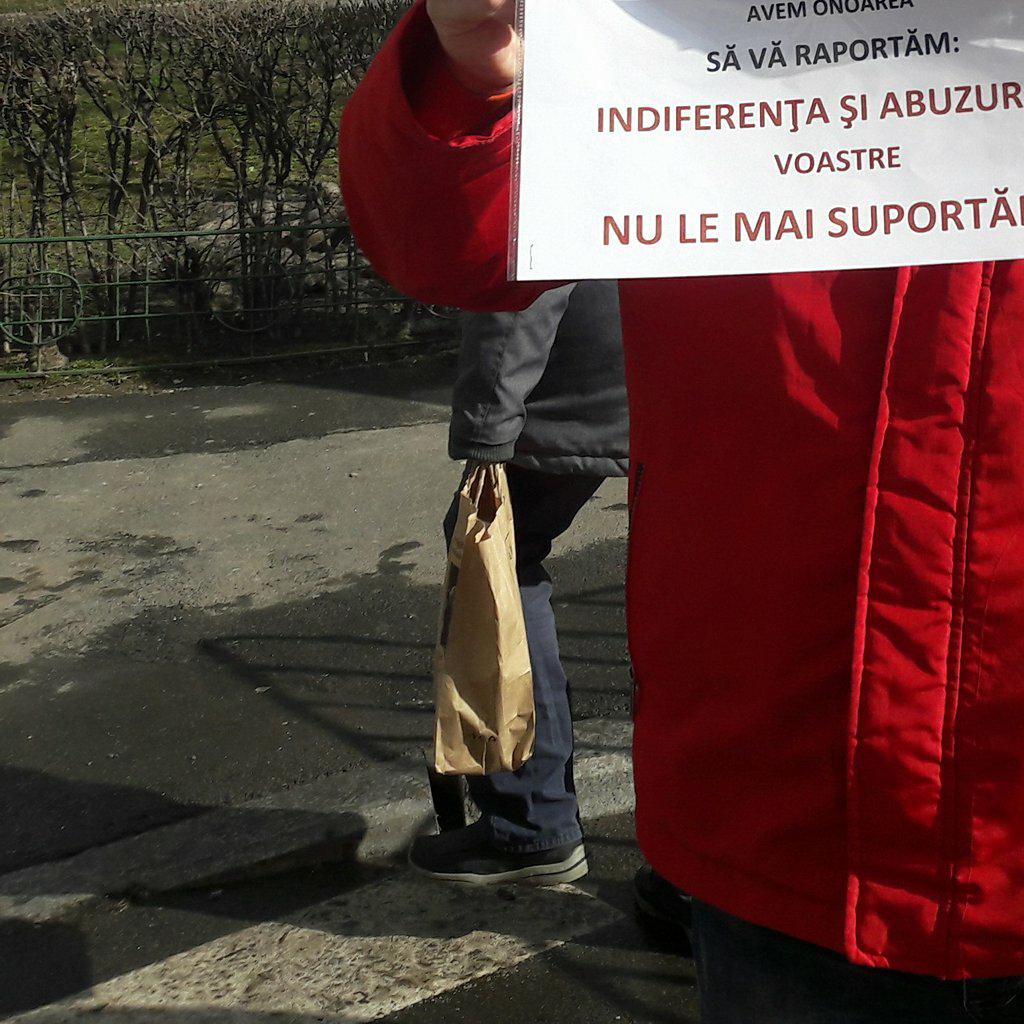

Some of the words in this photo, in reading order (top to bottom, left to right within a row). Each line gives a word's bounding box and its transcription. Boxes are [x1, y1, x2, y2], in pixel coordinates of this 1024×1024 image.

[747, 0, 807, 22] AVEM
[706, 44, 741, 73] SĂ
[748, 40, 787, 70] VĂ
[795, 28, 960, 67] RAPORTĂM:
[839, 94, 868, 129] ŞI
[774, 146, 902, 175] VOASTRE
[603, 214, 662, 246] NU
[680, 213, 719, 244] LE
[735, 209, 813, 242] MAI
